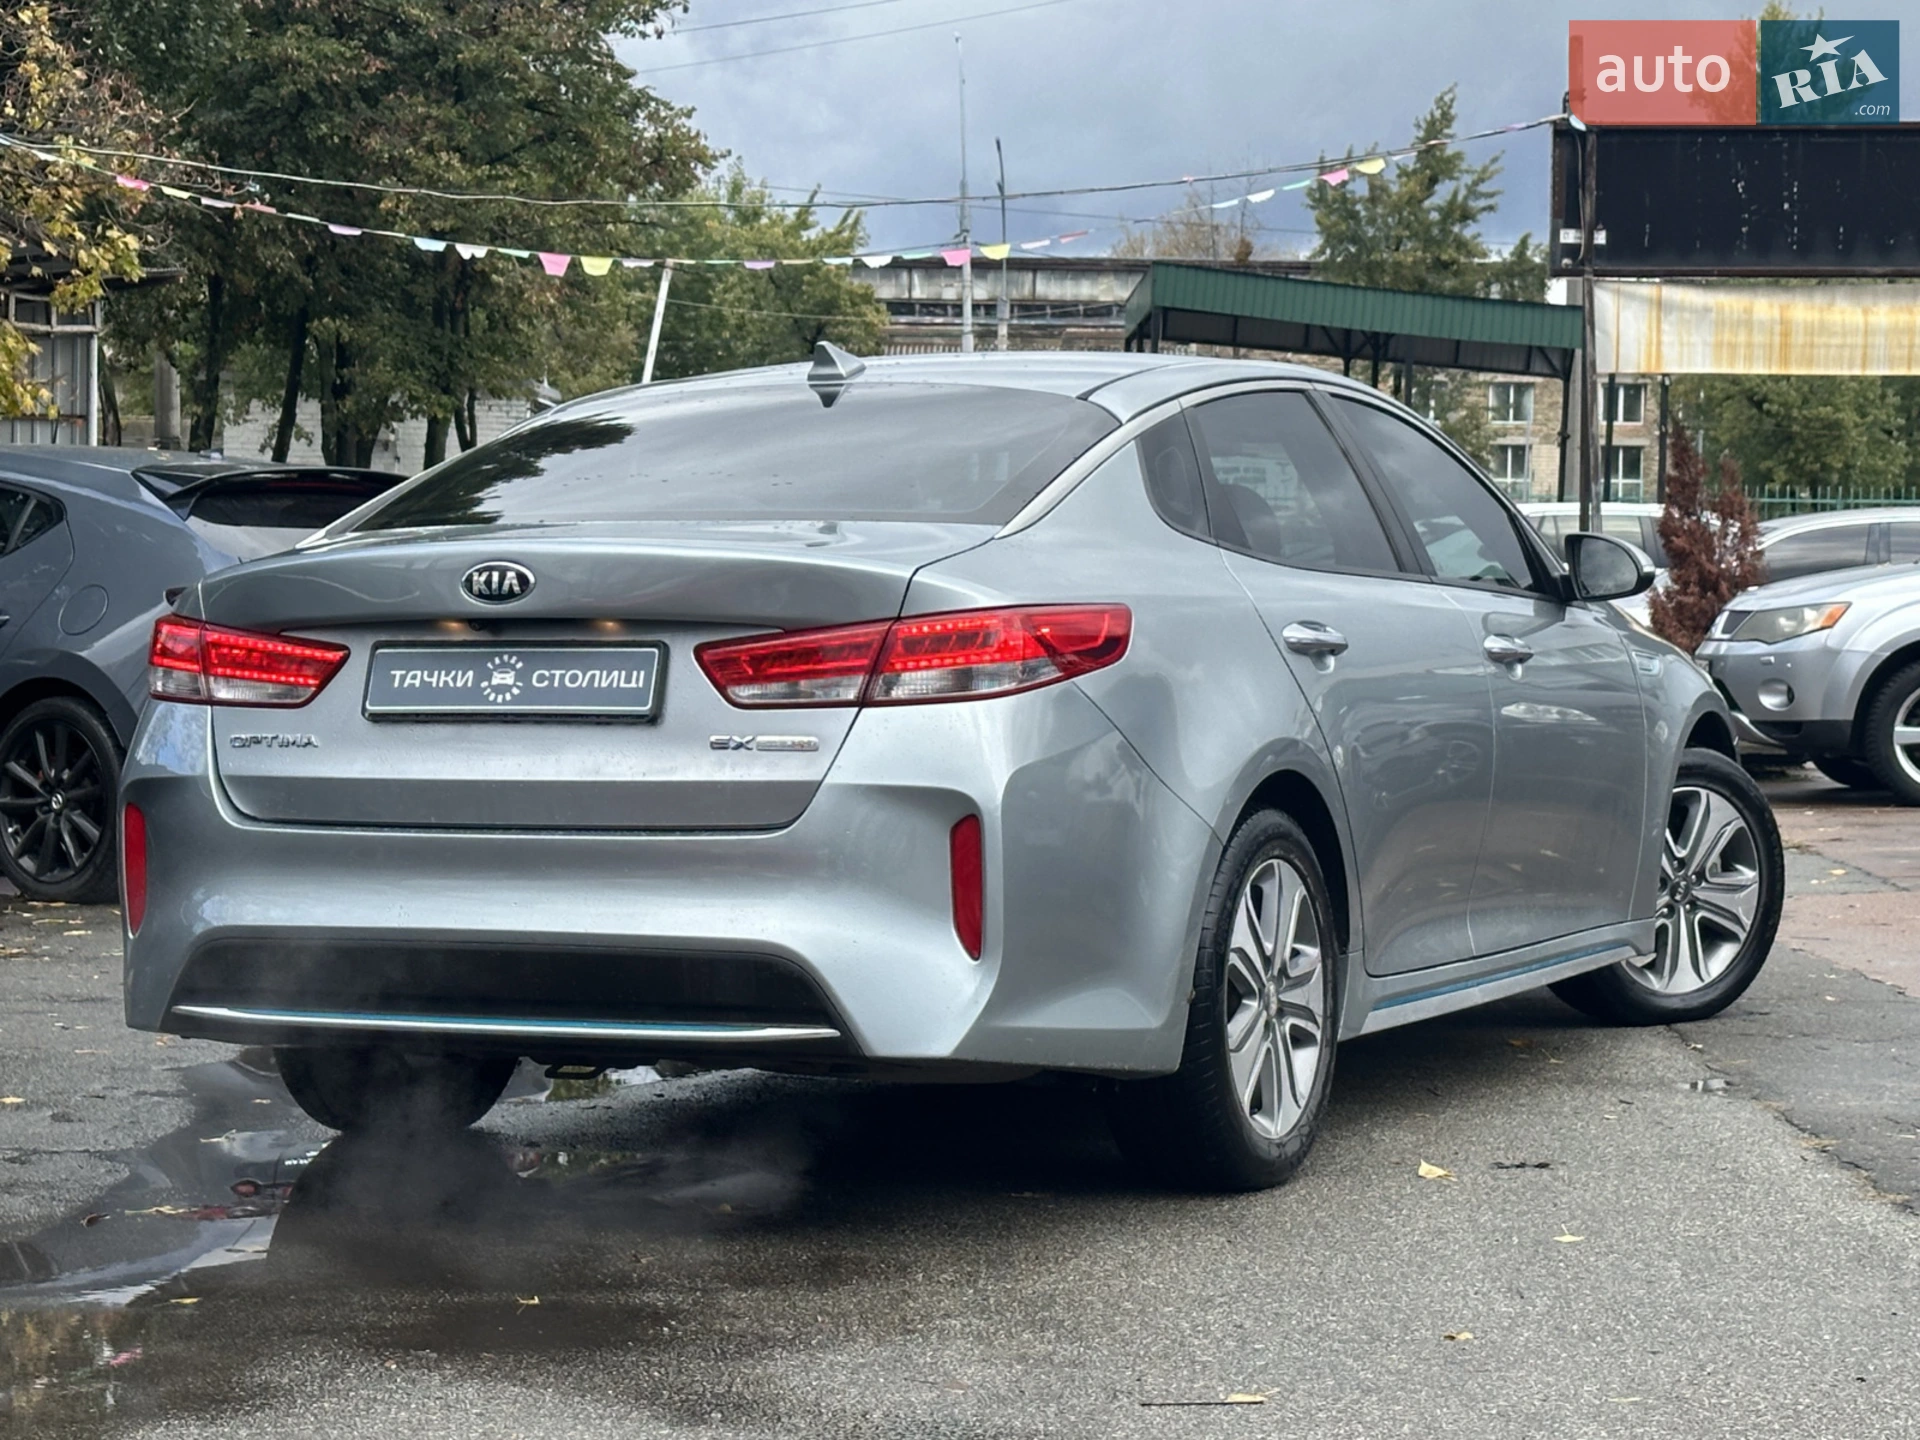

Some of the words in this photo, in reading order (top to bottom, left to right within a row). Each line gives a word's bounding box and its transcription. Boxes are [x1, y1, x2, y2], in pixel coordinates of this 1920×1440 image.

[472, 570, 522, 595] KIA
[390, 669, 475, 689] ТАЧКИ
[531, 669, 645, 689] СТОЛИЦІ
[229, 733, 320, 749] OPTIMA
[708, 734, 756, 751] EX
